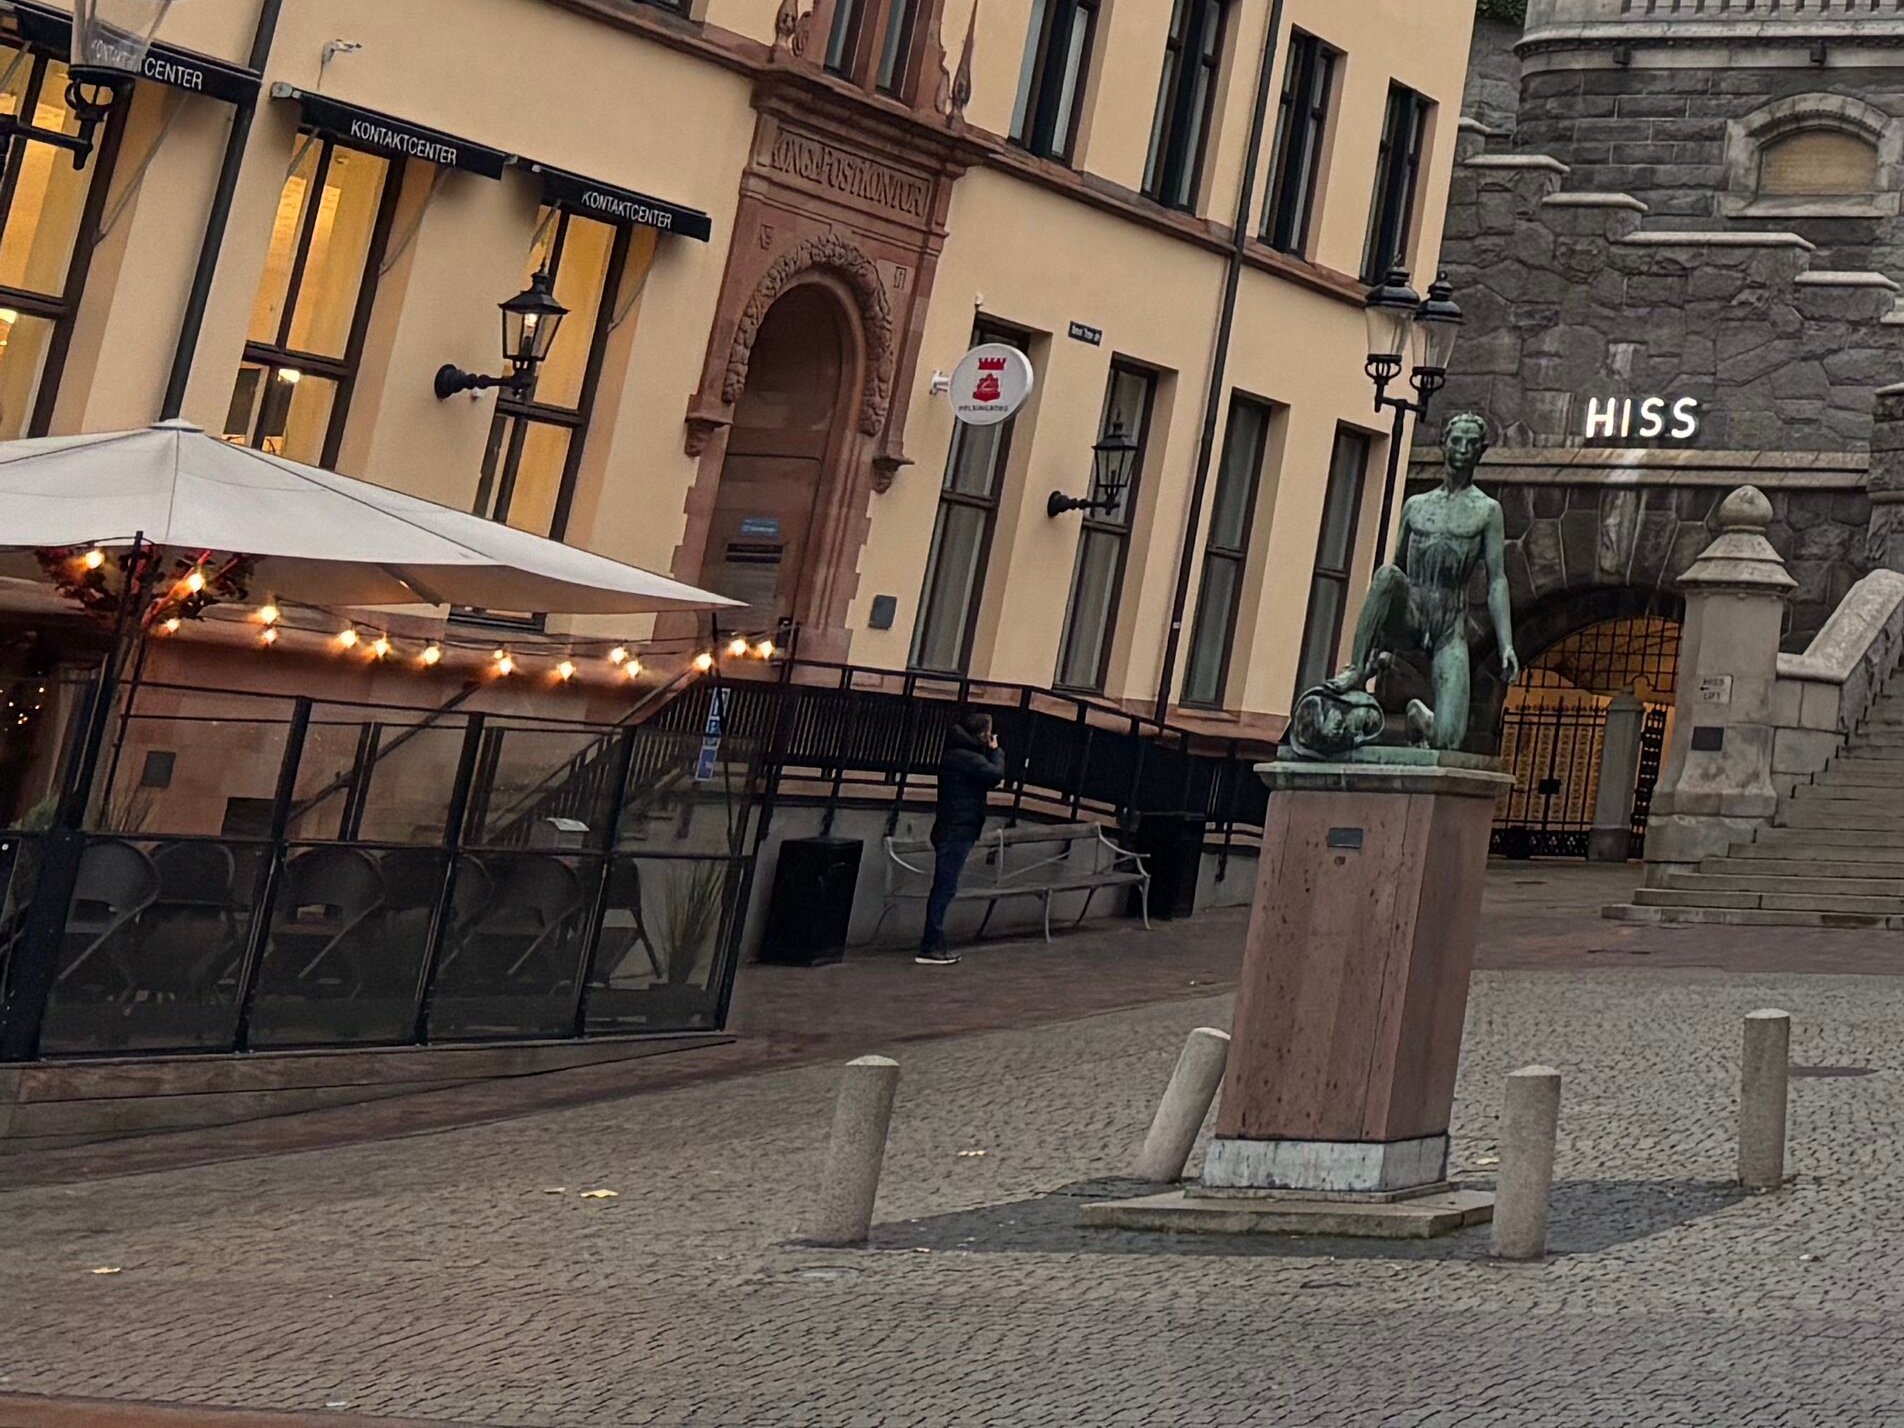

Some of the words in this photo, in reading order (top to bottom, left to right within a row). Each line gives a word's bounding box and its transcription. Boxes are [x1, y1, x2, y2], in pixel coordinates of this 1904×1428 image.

[350, 118, 458, 166] KONTAKTCENTER
[581, 190, 674, 230] KONTAKTCENTER
[1585, 396, 1698, 439] HISS
